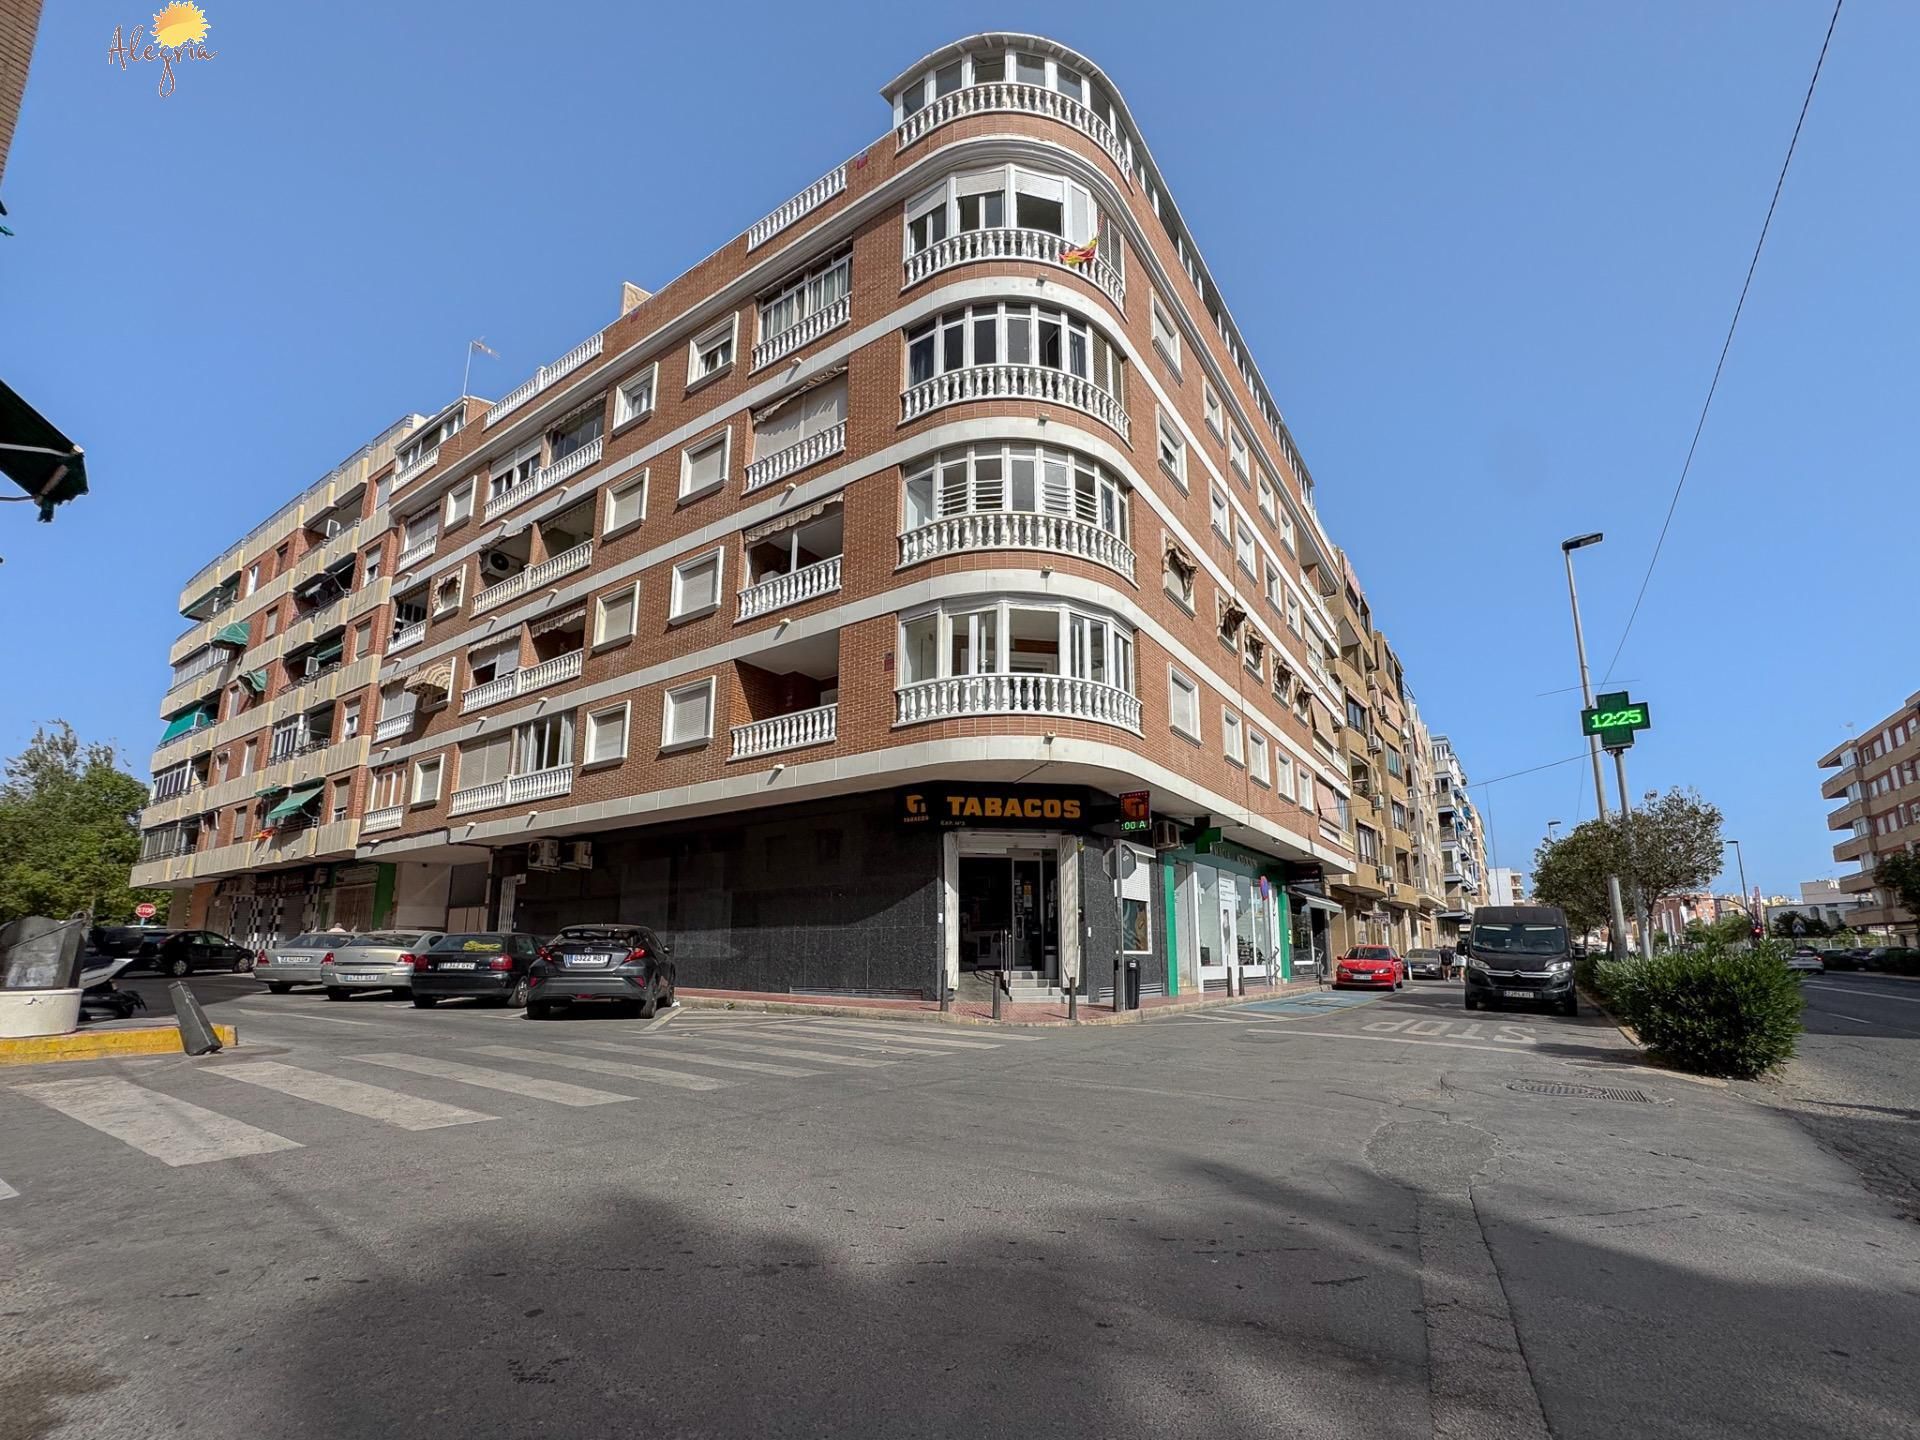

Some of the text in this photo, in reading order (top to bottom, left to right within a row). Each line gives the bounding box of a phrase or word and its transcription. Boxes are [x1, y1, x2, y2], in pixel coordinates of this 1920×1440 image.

[1591, 709, 1642, 728] 12:25
[946, 796, 1081, 819] TABACOS
[1361, 1018, 1537, 1045] STOP
